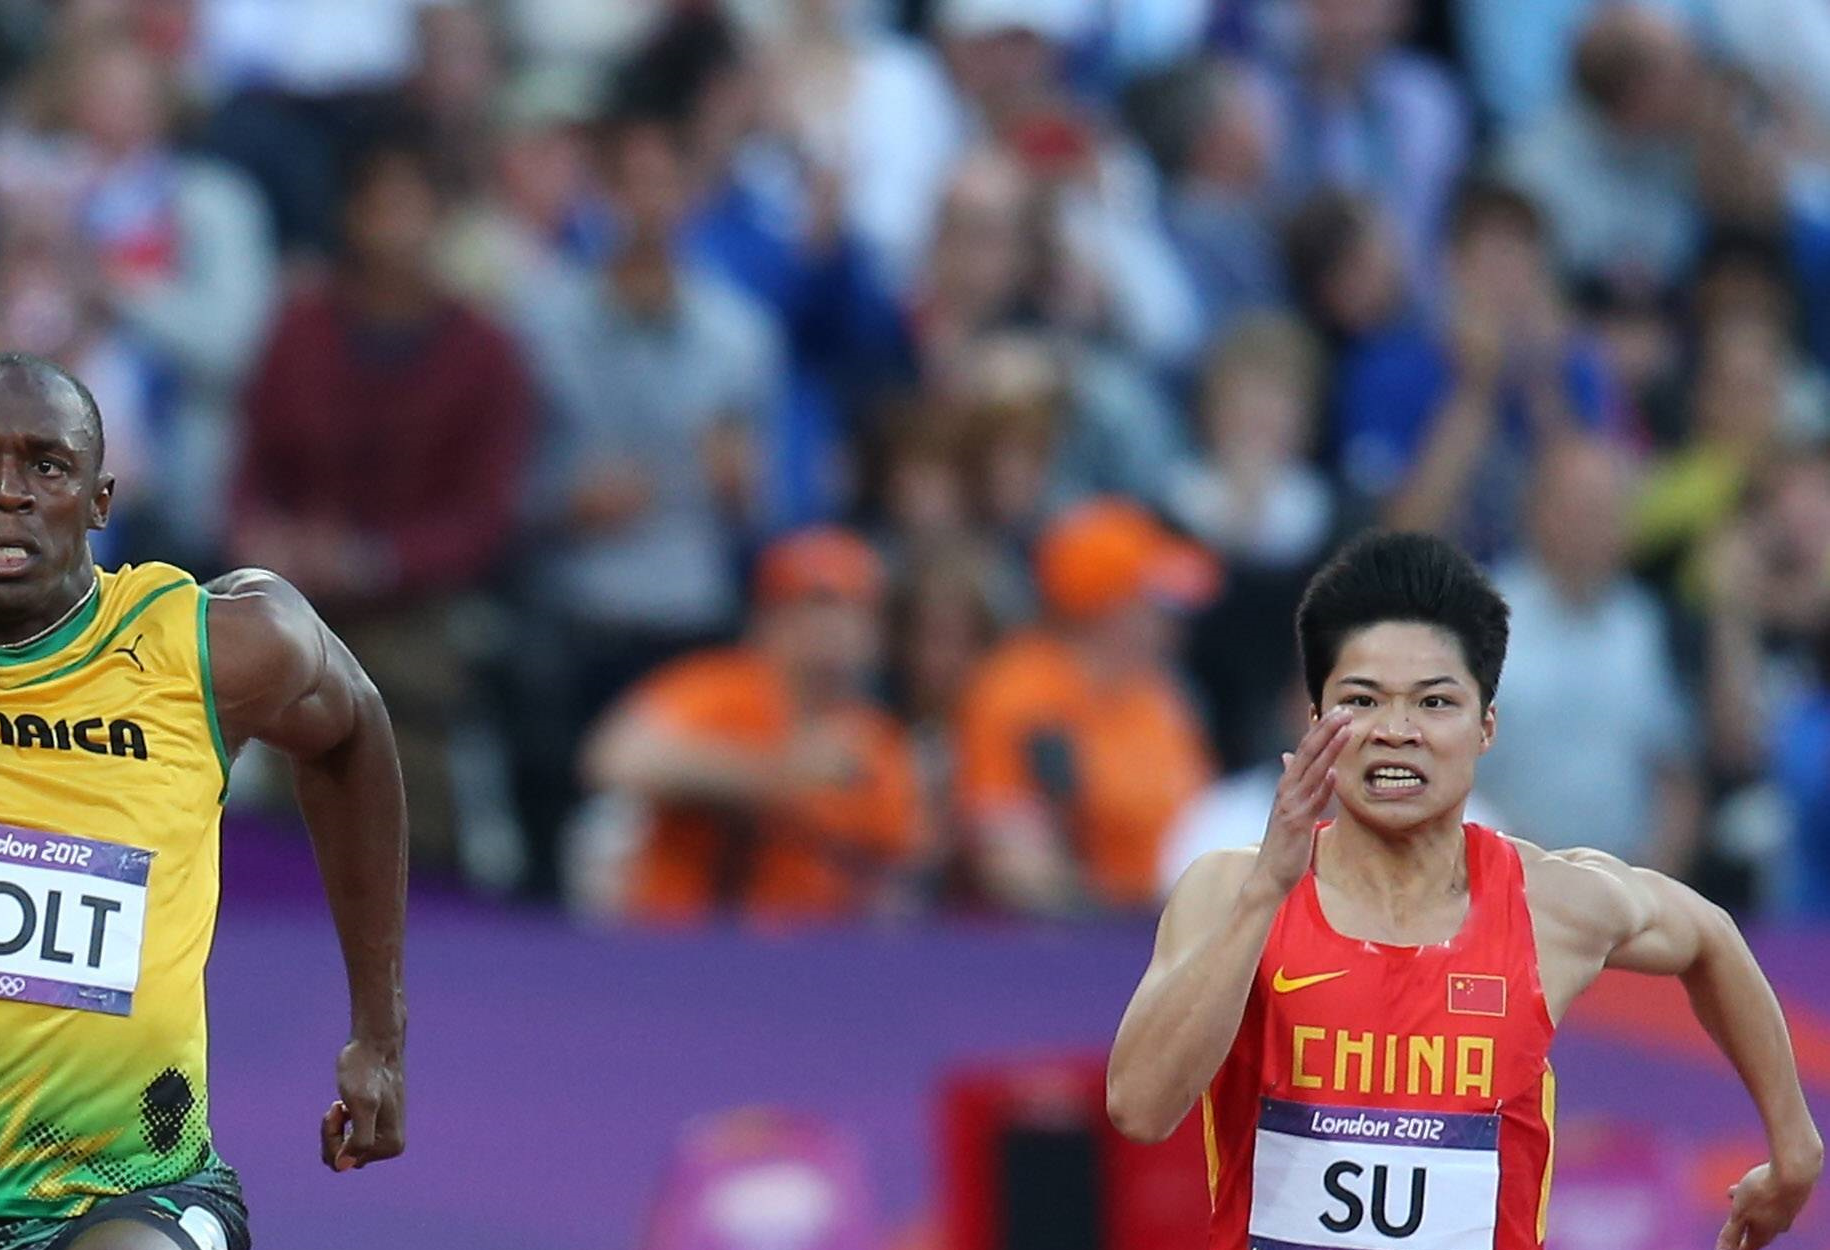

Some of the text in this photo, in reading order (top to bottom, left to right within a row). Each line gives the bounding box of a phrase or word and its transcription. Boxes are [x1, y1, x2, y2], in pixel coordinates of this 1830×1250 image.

[40, 840, 93, 867] 2012
[1291, 1025, 1495, 1098] CHINA
[1311, 1111, 1445, 1141] London 2012
[1318, 1160, 1428, 1239] SU
